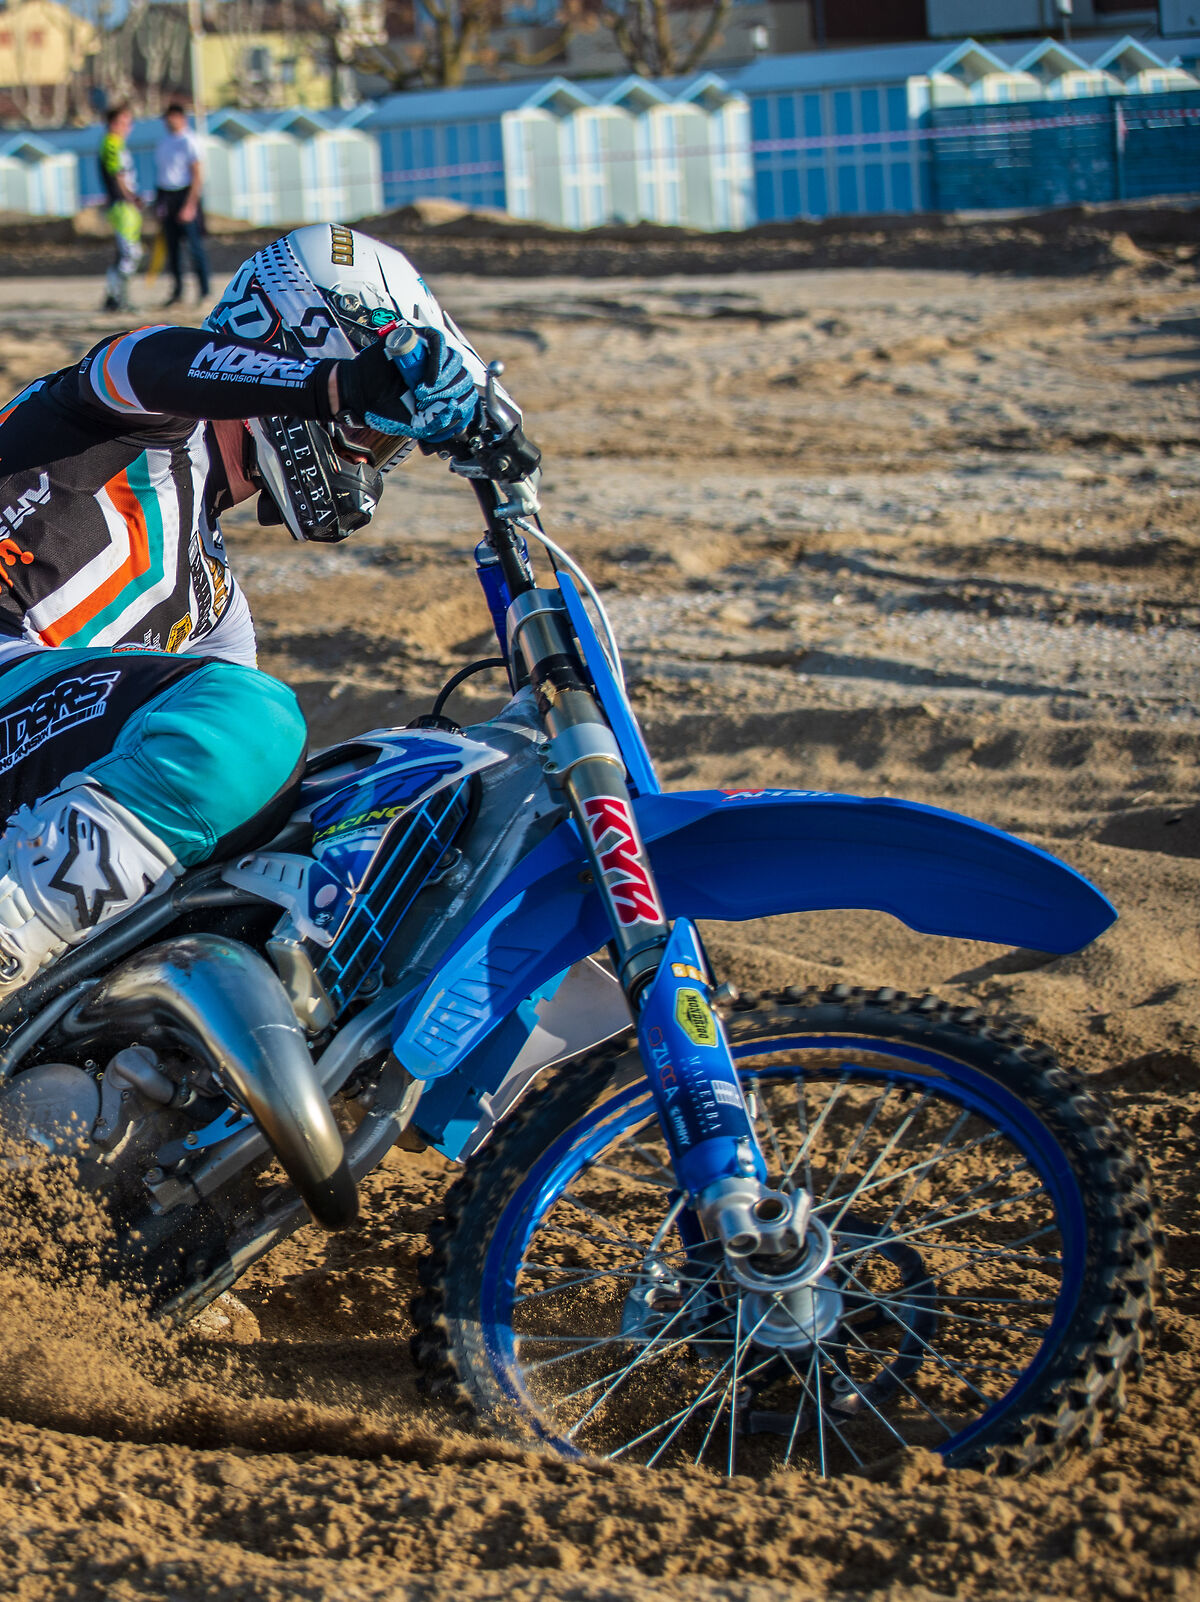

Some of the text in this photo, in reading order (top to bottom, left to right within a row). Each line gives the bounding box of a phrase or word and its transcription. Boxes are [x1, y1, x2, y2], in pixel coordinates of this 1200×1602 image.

[187, 368, 260, 384] RACING DIVISION
[285, 417, 332, 522] LERBA
[582, 795, 664, 929] KYB
[688, 1055, 722, 1130] MALERBA
